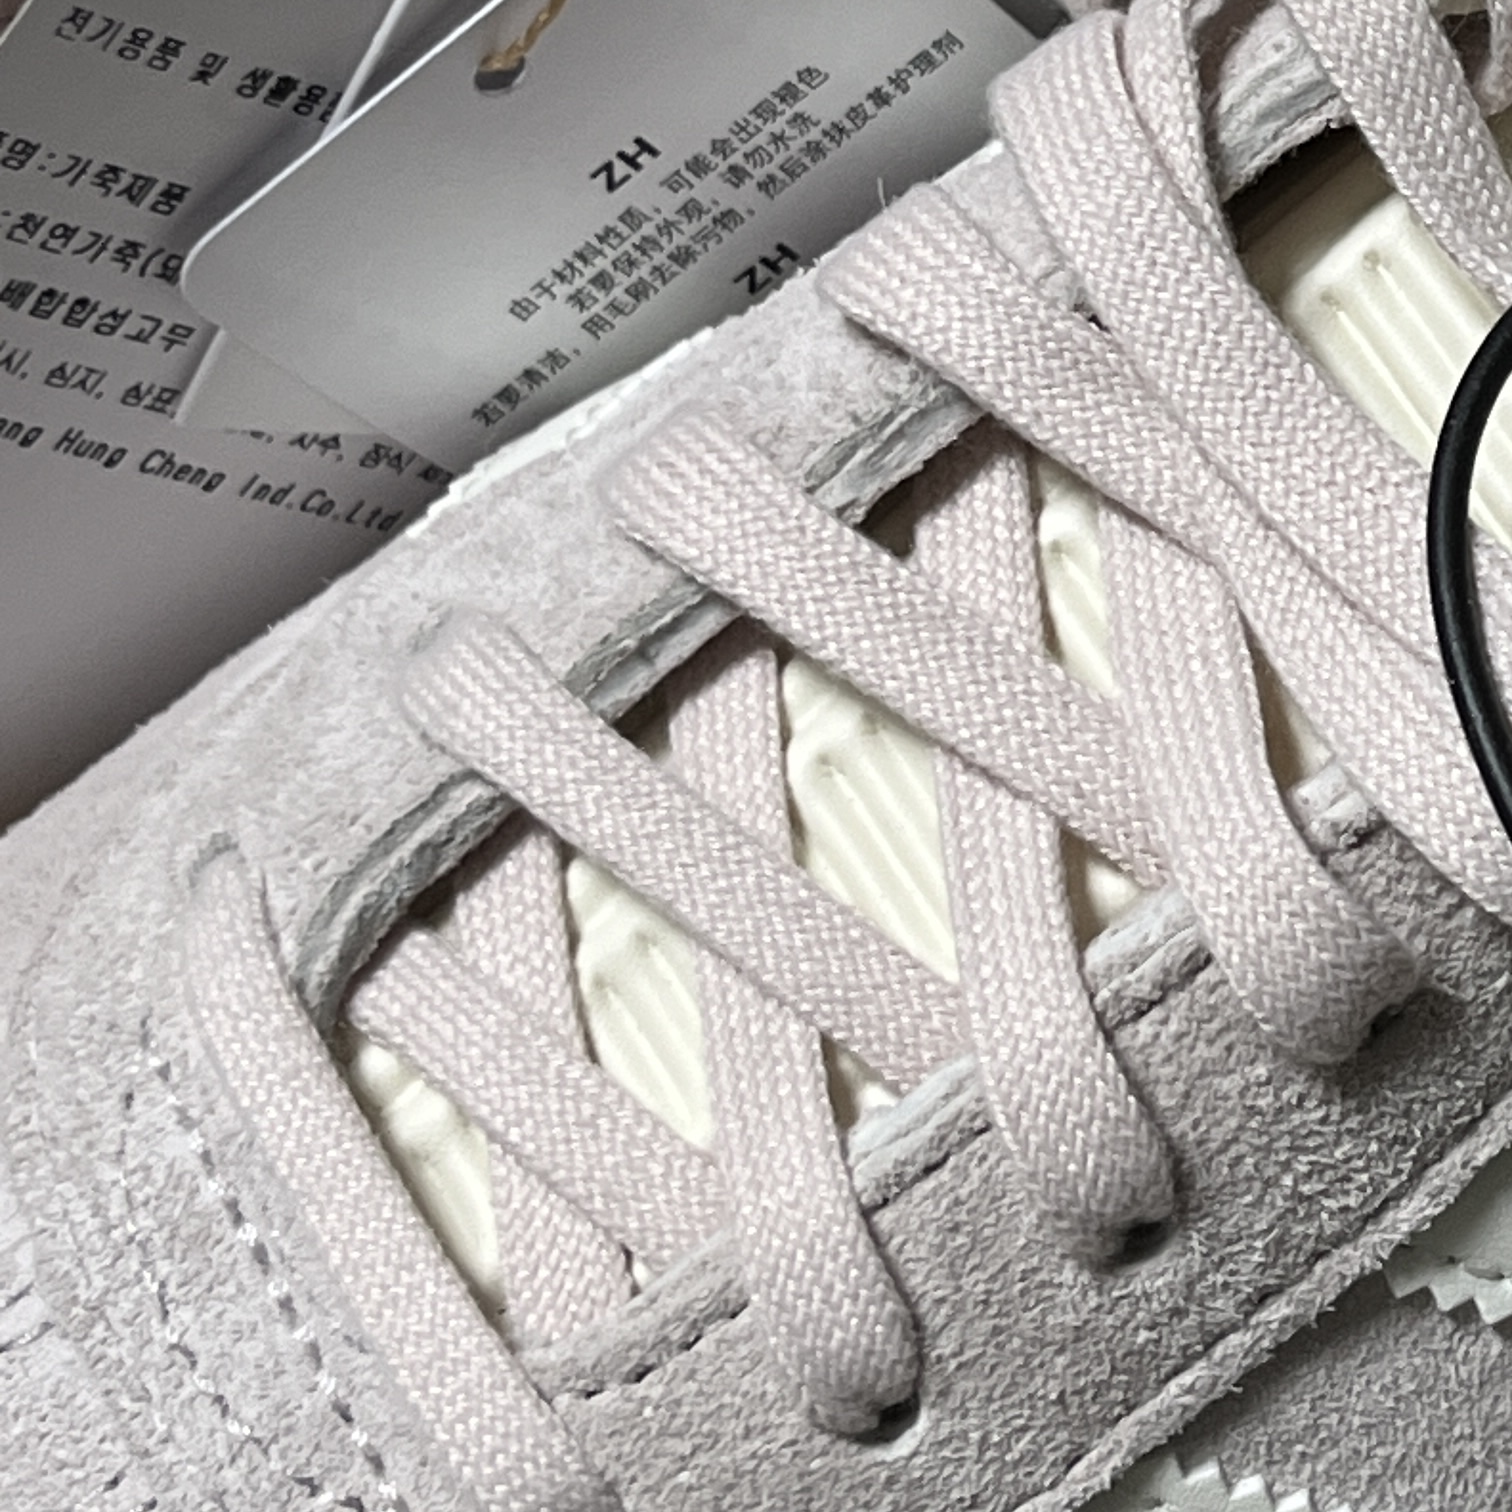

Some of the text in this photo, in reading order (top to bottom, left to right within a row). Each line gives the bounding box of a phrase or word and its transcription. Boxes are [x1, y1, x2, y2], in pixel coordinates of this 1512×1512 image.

[55, 6, 188, 72] 전기용품
[189, 52, 230, 86] 및
[0, 131, 192, 217] 명:가죽제품
[590, 135, 662, 193] ZH
[734, 242, 801, 295] ZH
[53, 426, 128, 469] Hung
[139, 449, 226, 493] Cheng
